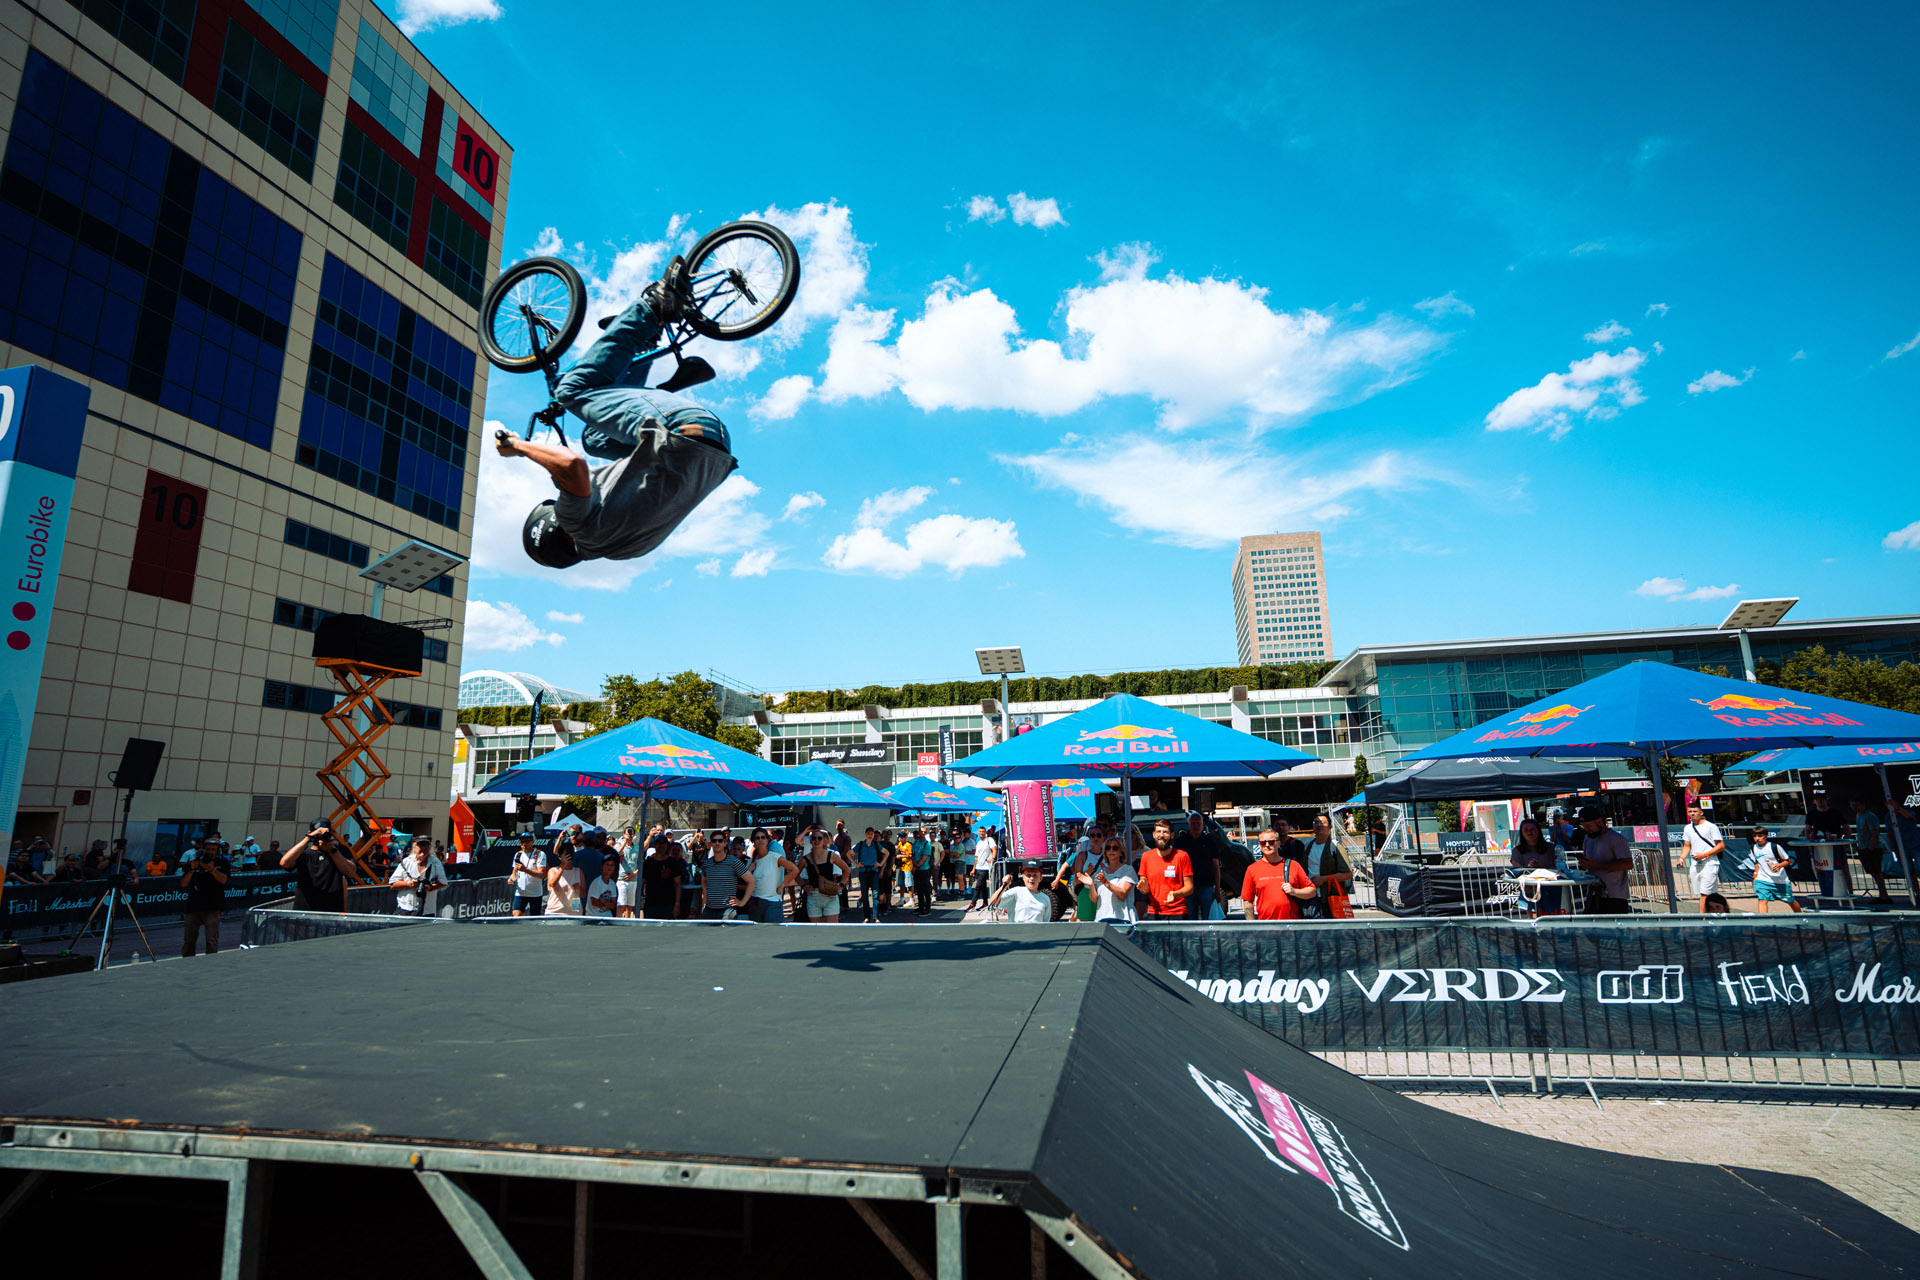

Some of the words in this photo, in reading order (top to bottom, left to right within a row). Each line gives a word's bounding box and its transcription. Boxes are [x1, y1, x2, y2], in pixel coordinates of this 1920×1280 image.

[461, 133, 493, 190] 10
[152, 485, 198, 530] 10
[18, 496, 55, 593] Eurobike
[1713, 712, 1801, 727] Red
[1780, 712, 1864, 726] Bull
[1473, 725, 1527, 743] Red
[1514, 721, 1574, 738] Bull
[811, 750, 846, 760] Sunday
[850, 748, 885, 758] Sunday
[1063, 741, 1124, 756] Red
[1129, 741, 1189, 753] Bull
[1857, 743, 1915, 757] Red
[618, 756, 675, 768] Red
[678, 758, 730, 772] Bull
[1041, 785, 1049, 804] fast
[1064, 787, 1089, 797] Bull
[1043, 805, 1051, 834] action
[45, 897, 96, 911] Marshall
[137, 891, 189, 904] Eurobike
[458, 900, 511, 918] Eurobike
[1835, 962, 1920, 1003] Mar
[1298, 1104, 1350, 1168] CONTEST
[1328, 1158, 1392, 1237] SKYLINE
